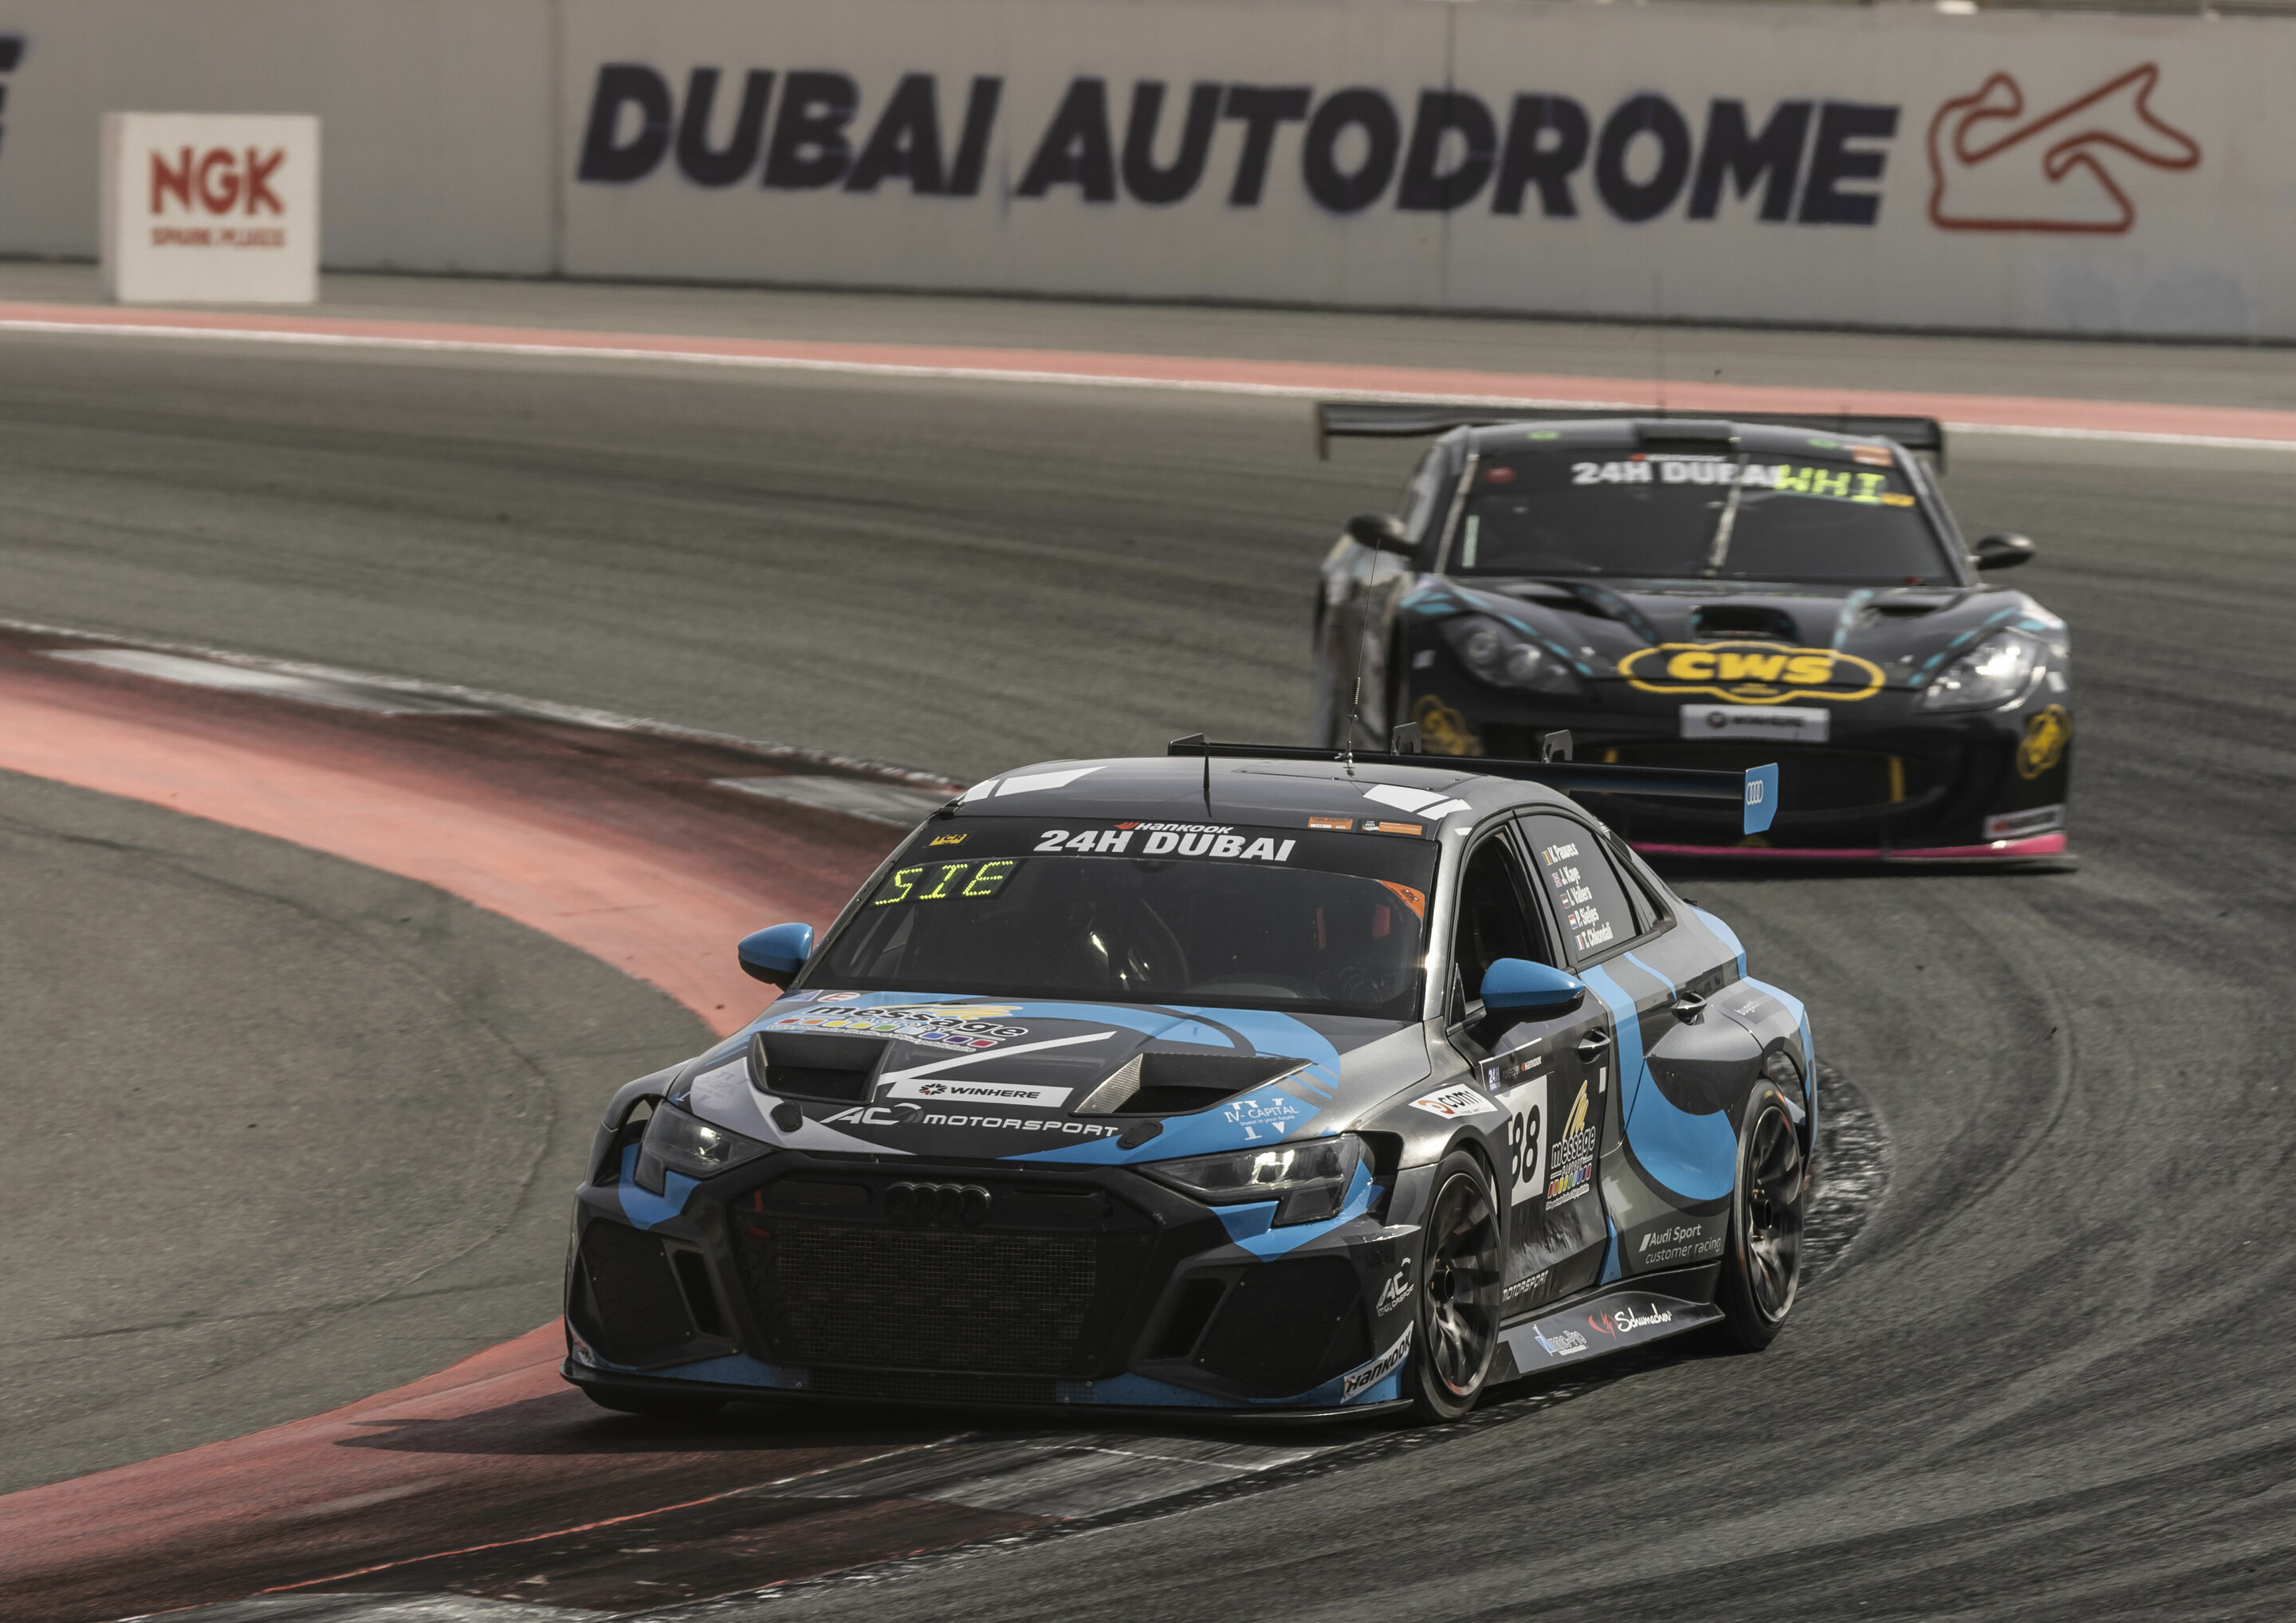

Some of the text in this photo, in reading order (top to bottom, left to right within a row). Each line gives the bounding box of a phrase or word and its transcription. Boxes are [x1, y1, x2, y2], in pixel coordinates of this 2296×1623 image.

[576, 62, 1901, 226] DUBAI AUTODROME
[150, 146, 286, 216] NGK
[1571, 462, 1653, 485] 24H
[1667, 651, 1834, 685] CWS
[1033, 830, 1296, 862] 24H DUBAI
[875, 860, 1013, 906] SIE
[803, 1004, 1028, 1037] message
[950, 1086, 1041, 1099] WINHERE
[820, 1106, 1119, 1137] AC MOTORSPORT
[1248, 1105, 1299, 1118] CAPITAL
[1551, 1126, 1595, 1169] message
[1645, 1236, 1722, 1265] customer racing
[1649, 1224, 1702, 1247] Audi Sport
[1502, 1270, 1550, 1303] MOTORSPORT
